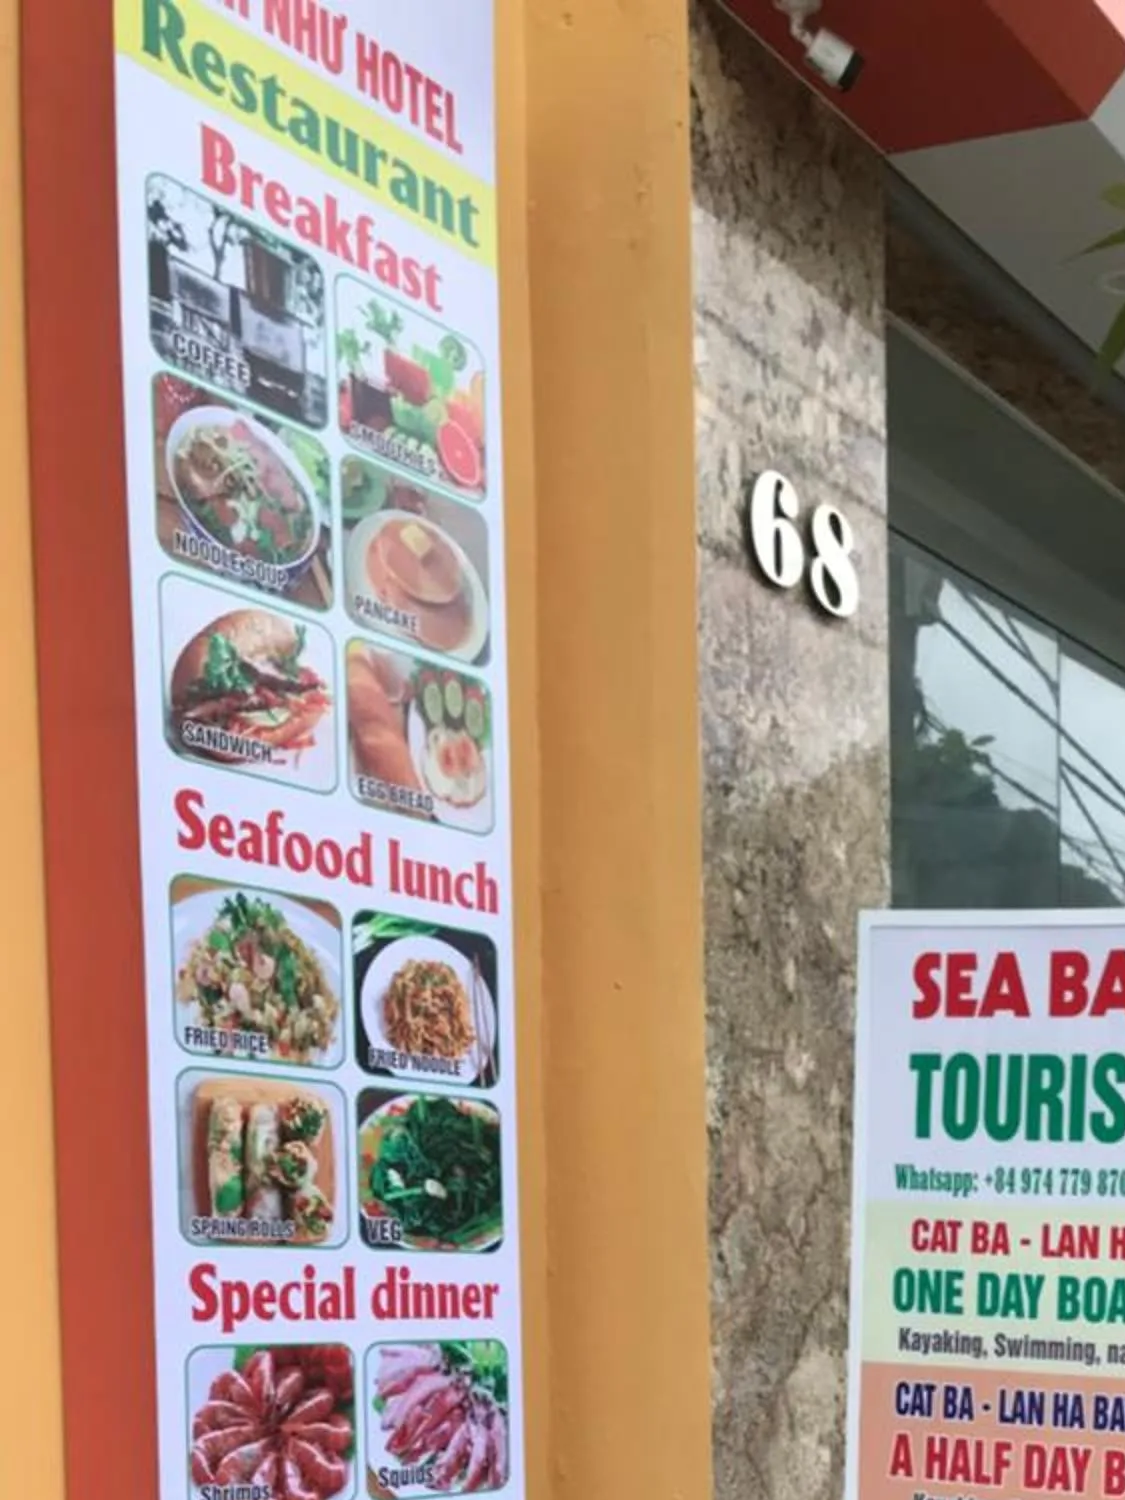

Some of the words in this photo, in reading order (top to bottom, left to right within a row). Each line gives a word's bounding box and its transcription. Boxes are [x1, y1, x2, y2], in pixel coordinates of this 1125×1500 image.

[356, 33, 463, 155] HOTEL
[141, 0, 480, 249] Restaurant
[200, 122, 444, 313] Breakfast
[173, 333, 250, 388] COFFEE
[751, 469, 859, 617] 68
[246, 556, 288, 588] SOUP
[355, 596, 418, 632] PANCAKE
[358, 778, 389, 800] EGG
[391, 790, 434, 812] BREAD
[174, 789, 374, 887] Seafood
[389, 838, 499, 914] lunch
[912, 952, 1031, 1018] SEA
[185, 1026, 228, 1049] FRIED
[232, 1033, 267, 1054] RICE
[369, 1048, 407, 1070] FRIED
[895, 1164, 978, 1197] Whatsapp:
[1021, 1169, 1053, 1196] 974
[1059, 1170, 1091, 1196] 779
[191, 1218, 247, 1238] SPRING
[250, 1221, 294, 1238] ROLLS
[365, 1219, 401, 1241] VEG
[912, 1219, 963, 1255] CAT
[971, 1223, 1010, 1256] BA
[1041, 1224, 1099, 1259] LAN
[189, 1263, 356, 1333] Special
[371, 1266, 500, 1320] dinner
[893, 1268, 963, 1316] ONE
[978, 1272, 1044, 1319] DAY
[899, 1327, 988, 1360] Kayaking,
[994, 1334, 1100, 1366] Swimming,
[895, 1382, 937, 1417] CAT
[944, 1385, 973, 1421] BA
[999, 1389, 1044, 1426] LAN
[1053, 1394, 1083, 1429] HA
[378, 1465, 434, 1490] Squids
[891, 1434, 912, 1477] A
[925, 1437, 1012, 1485] HALF
[1024, 1444, 1091, 1492] DAY
